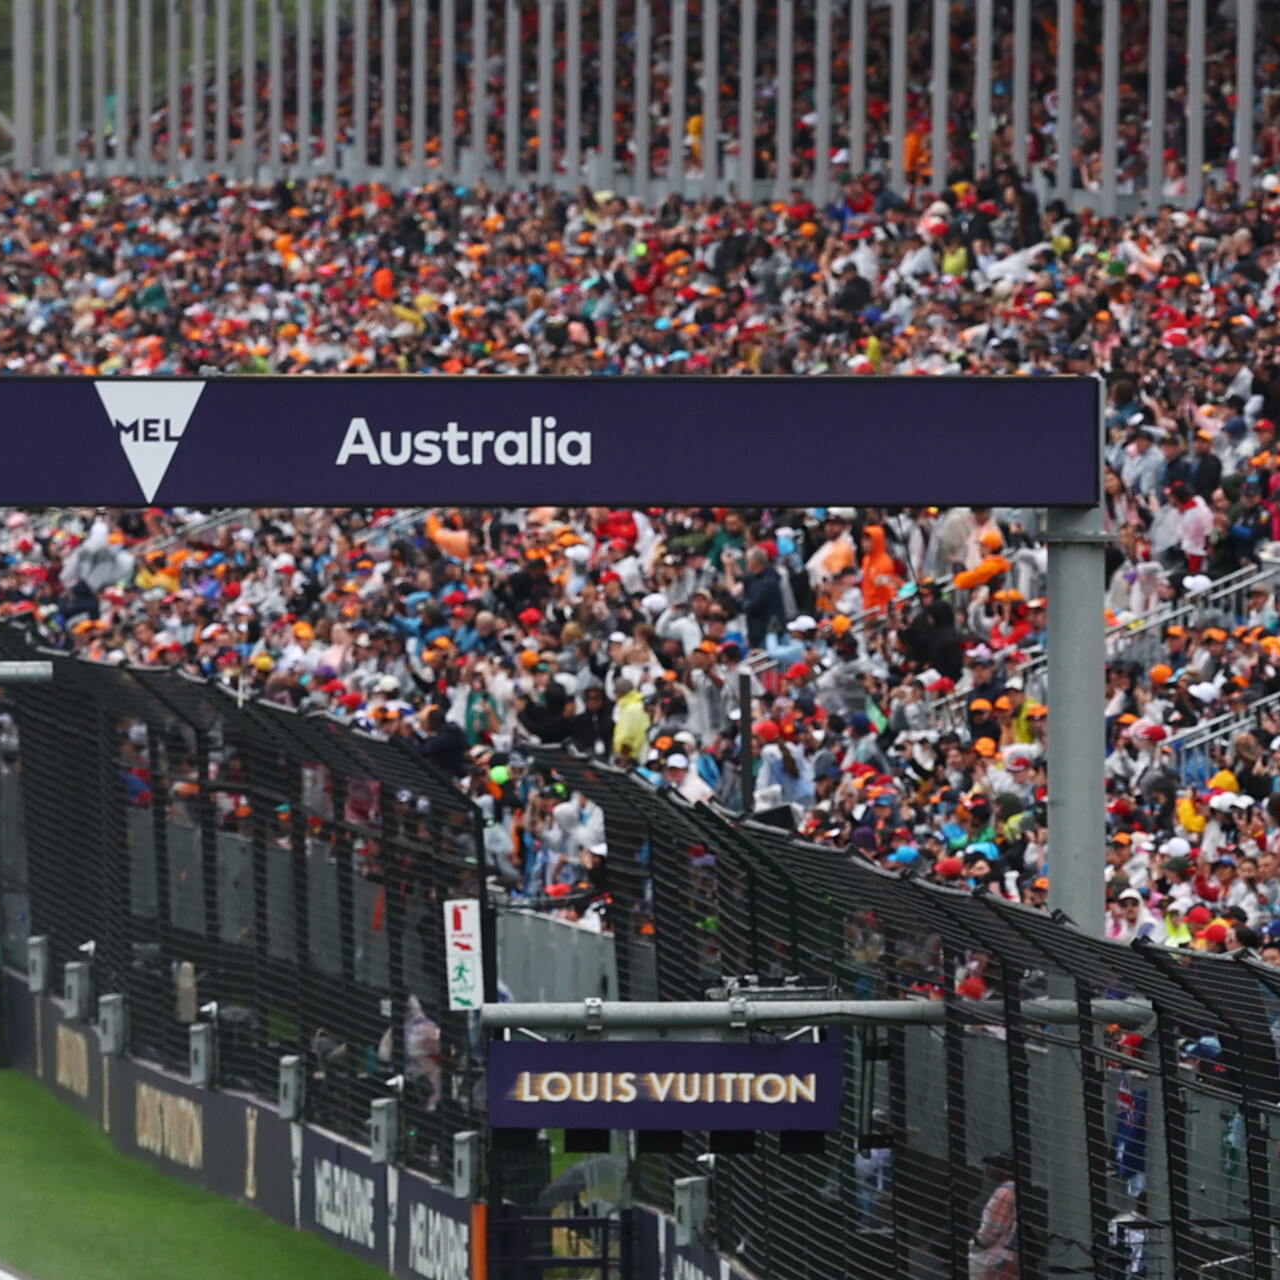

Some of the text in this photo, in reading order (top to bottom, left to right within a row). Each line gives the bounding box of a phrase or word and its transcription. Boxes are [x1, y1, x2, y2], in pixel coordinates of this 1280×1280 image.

[115, 418, 182, 442] MEL
[335, 416, 591, 466] Australia
[516, 1071, 817, 1104] LOUIS VUITTON
